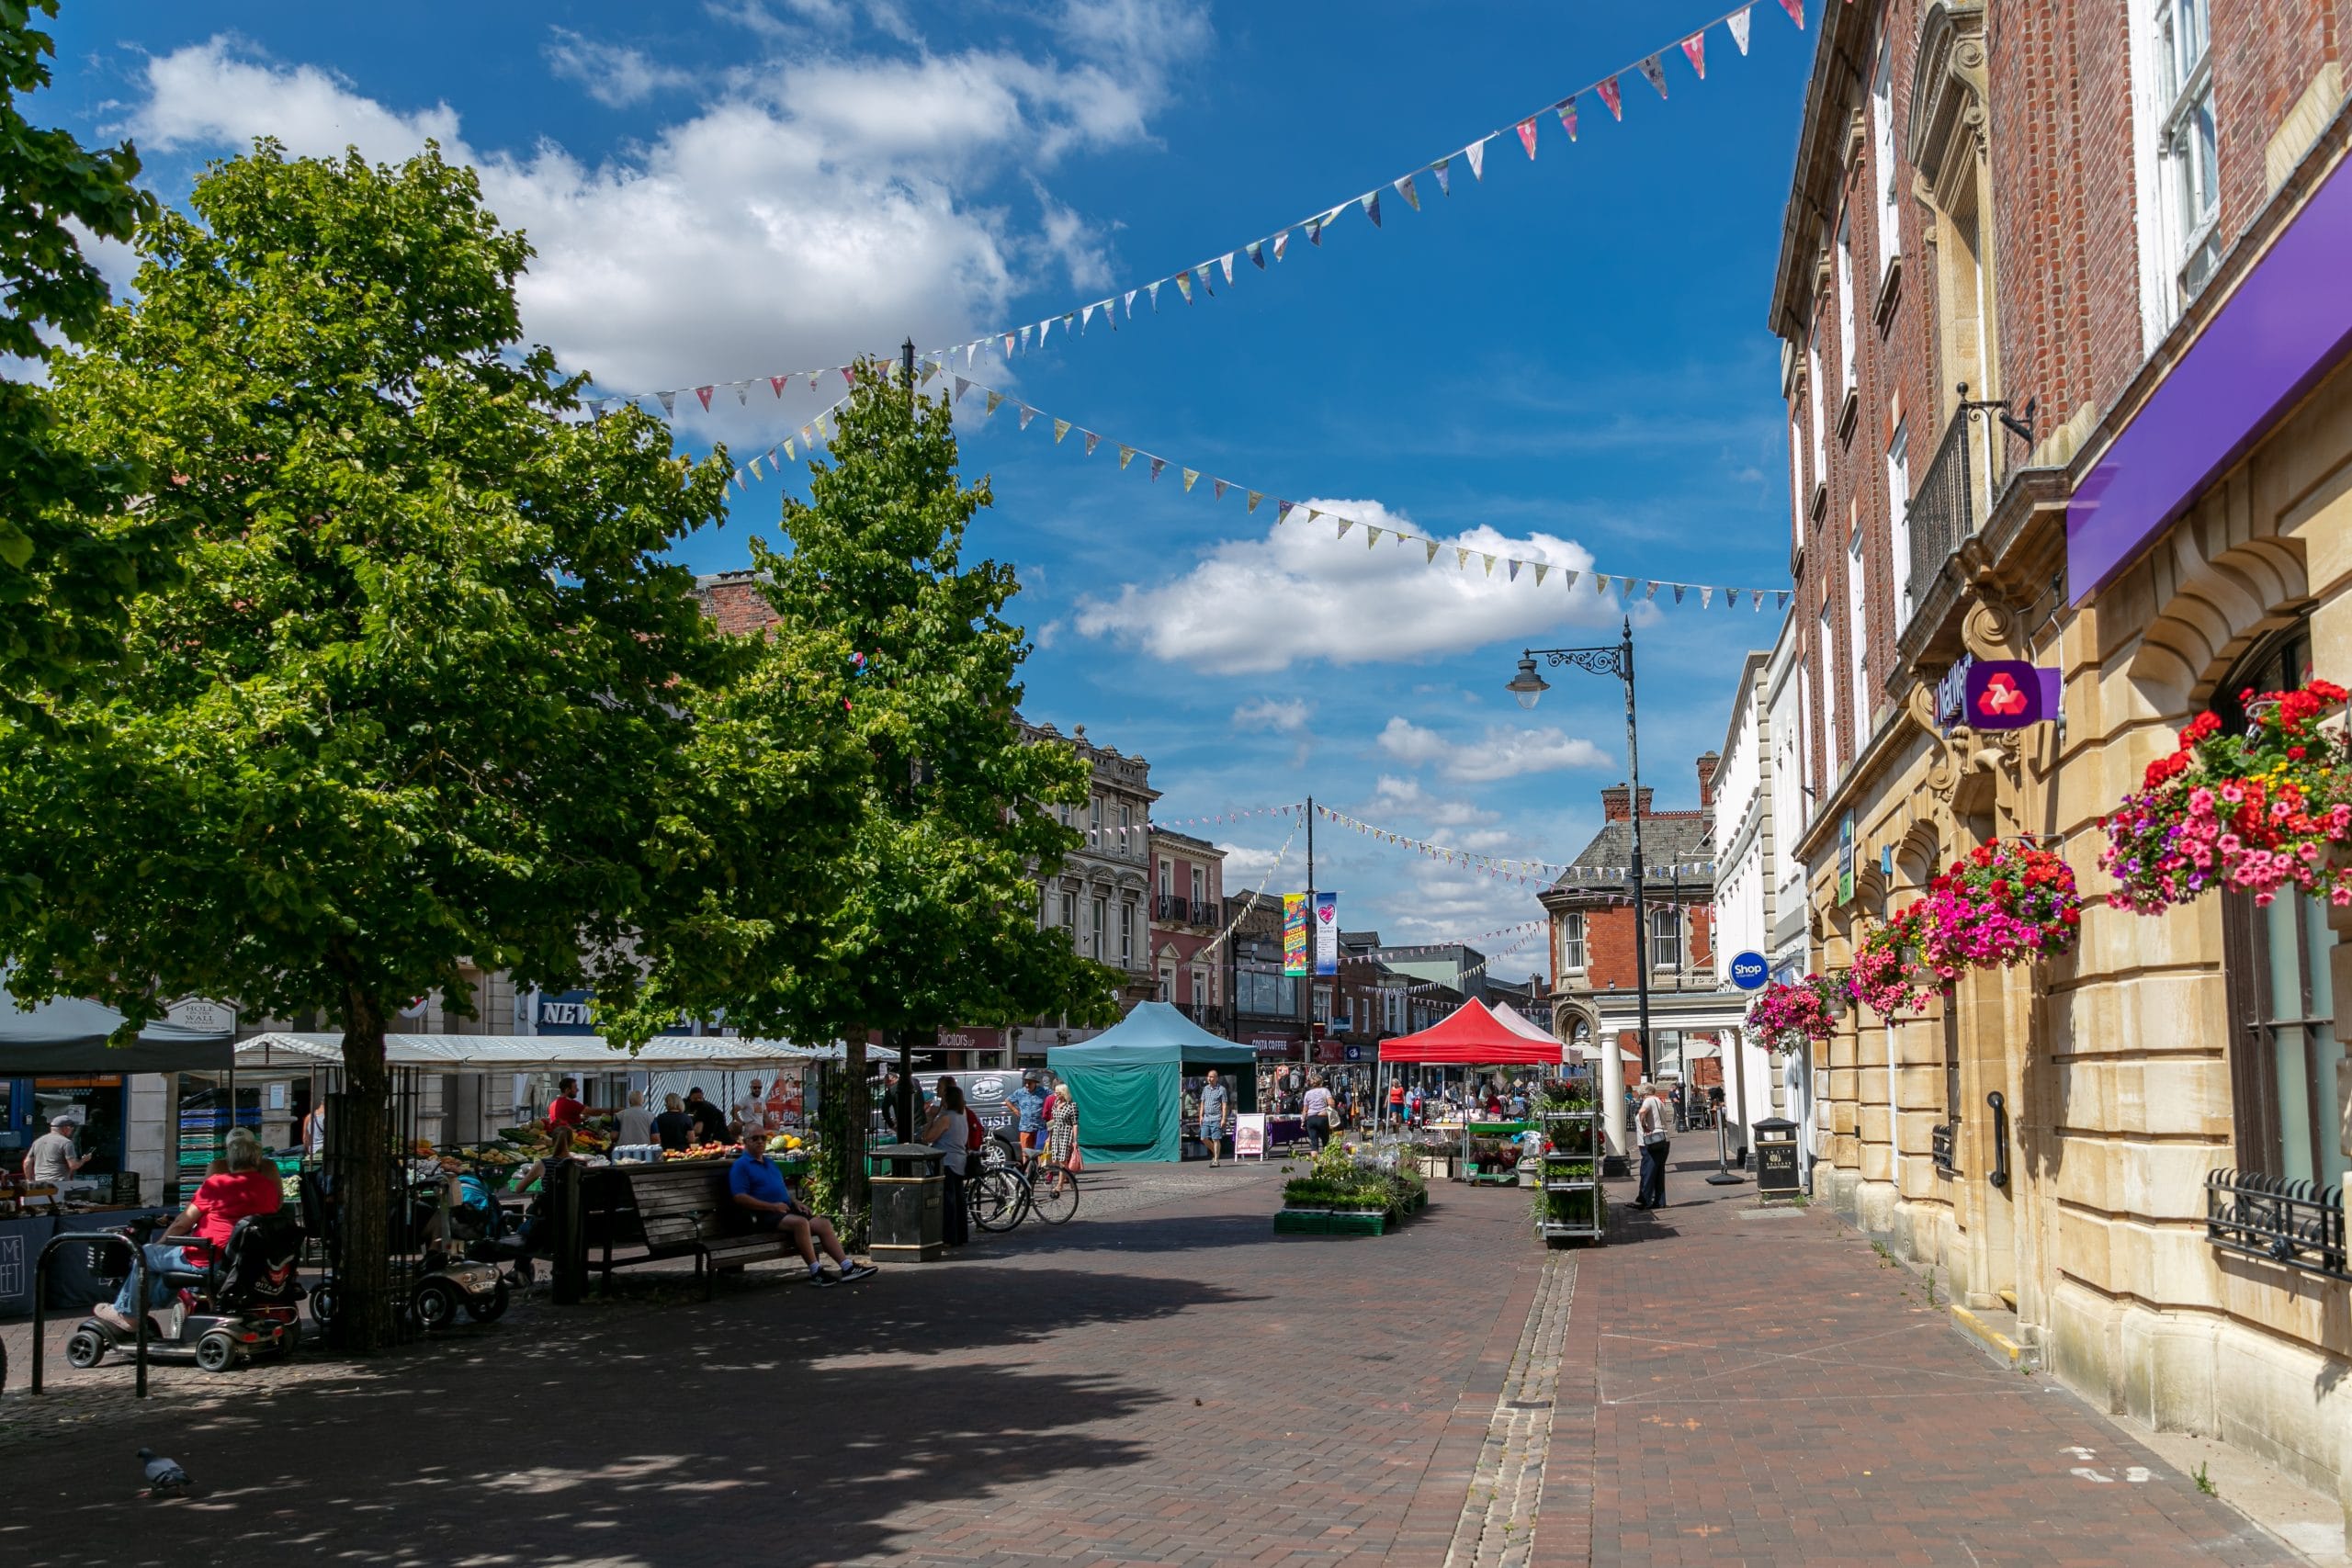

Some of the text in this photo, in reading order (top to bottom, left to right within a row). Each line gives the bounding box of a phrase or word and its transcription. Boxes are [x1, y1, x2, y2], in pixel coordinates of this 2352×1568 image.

[1287, 926, 1303, 935] YOUR
[1285, 932, 1306, 943] LOCAL
[1285, 939, 1305, 950] SHOPS
[1735, 964, 1761, 975] Shop
[938, 1031, 967, 1046] olicitors
[1251, 1039, 1287, 1051] COSTA COFFEE
[980, 1116, 1012, 1126] FISH
